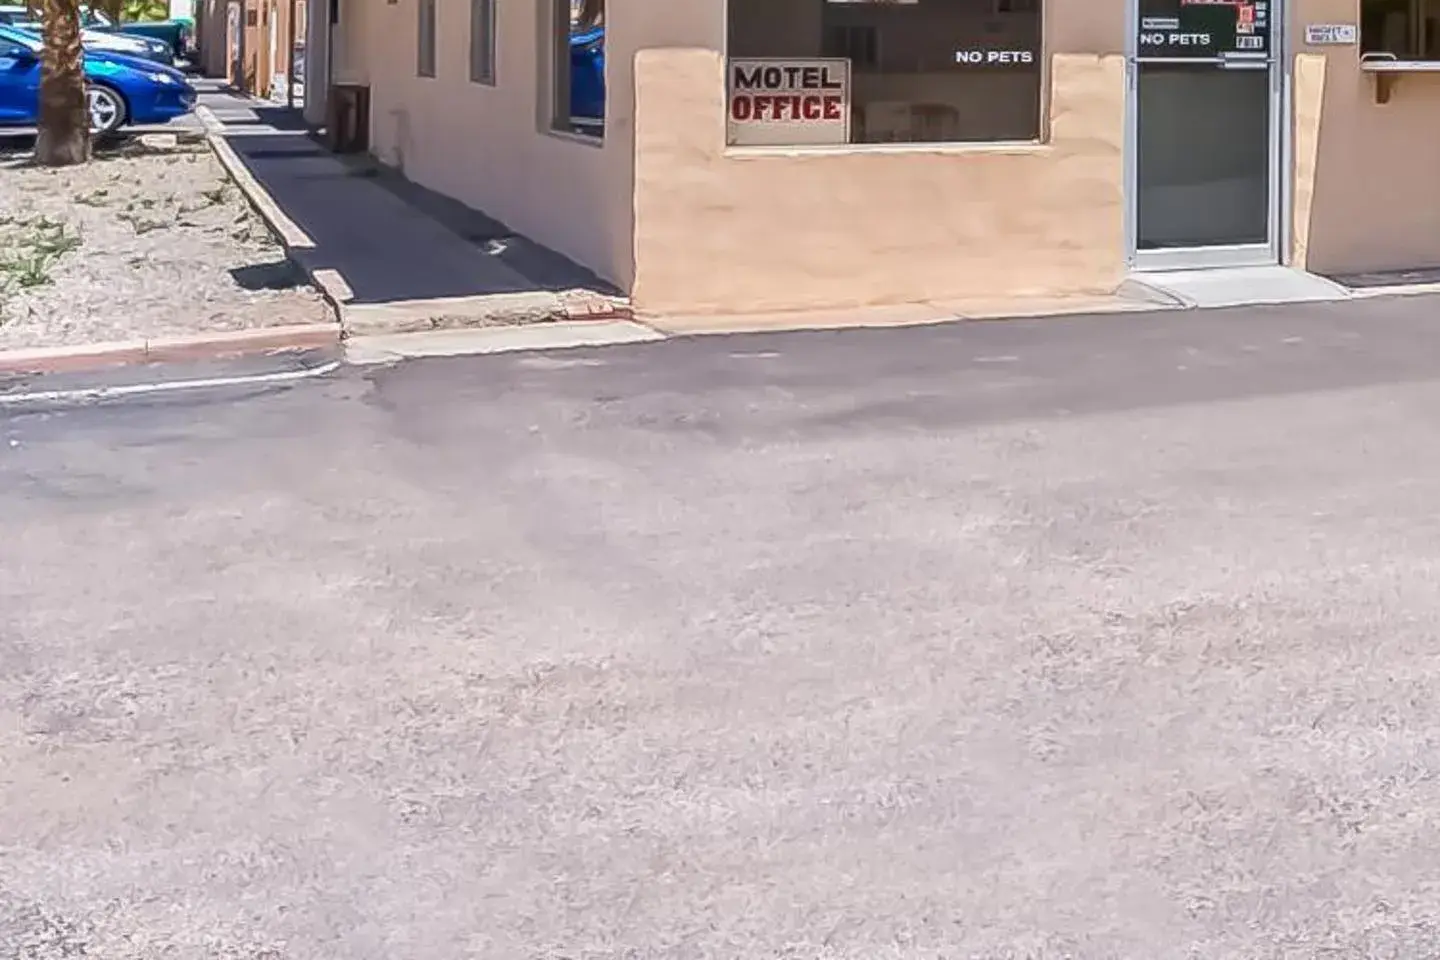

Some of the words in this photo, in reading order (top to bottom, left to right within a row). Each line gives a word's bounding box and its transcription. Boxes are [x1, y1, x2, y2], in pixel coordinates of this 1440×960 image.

[1140, 34, 1165, 45] NO
[1169, 34, 1211, 46] PETS
[956, 51, 982, 63] NO
[987, 51, 1033, 63] PETS
[735, 66, 842, 89] MOTEL
[732, 95, 842, 120] OFFICE
